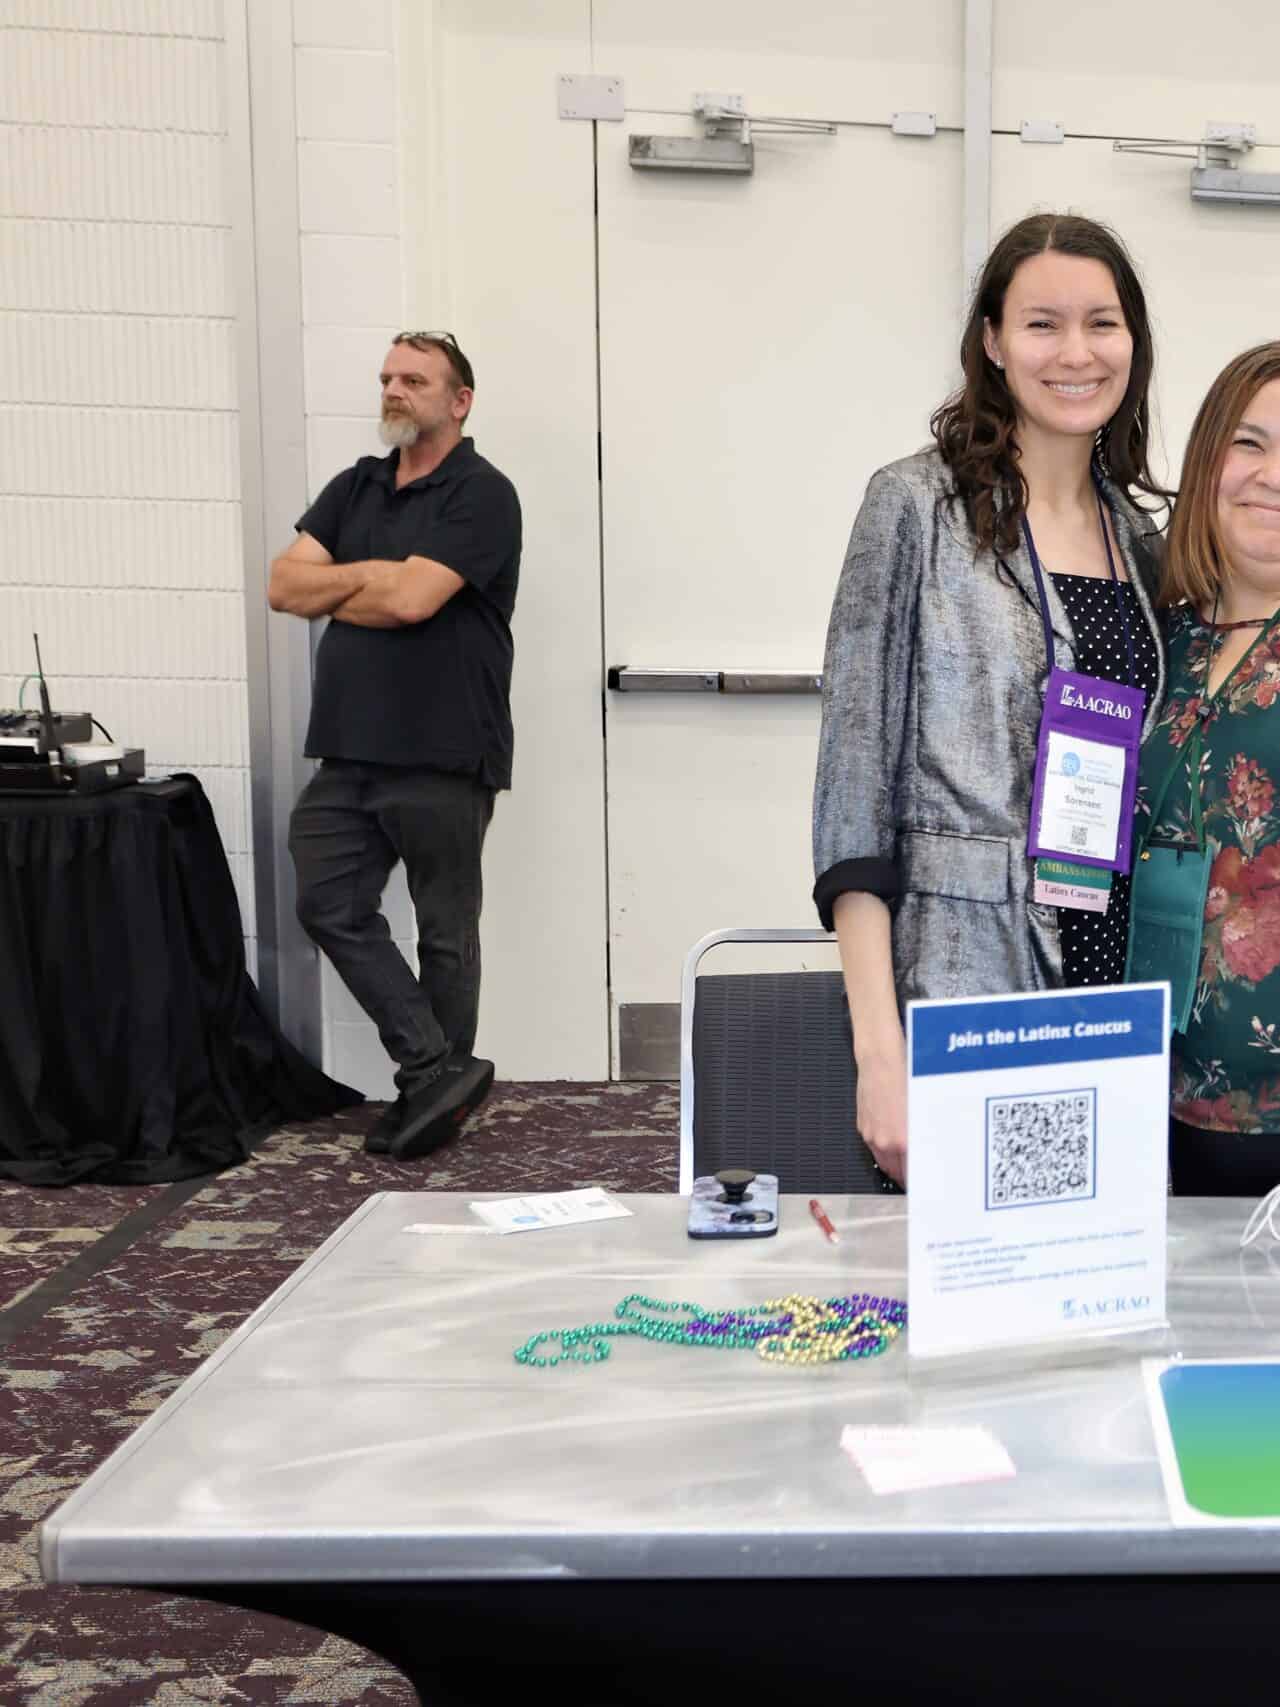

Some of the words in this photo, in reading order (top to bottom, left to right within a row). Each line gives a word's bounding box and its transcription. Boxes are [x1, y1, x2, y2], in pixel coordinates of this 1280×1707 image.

[1073, 694, 1132, 719] AACRAO
[948, 1032, 983, 1052] Join
[986, 1028, 1016, 1045] the
[1018, 1024, 1071, 1042] Latinx
[1074, 1020, 1132, 1037] Caucus
